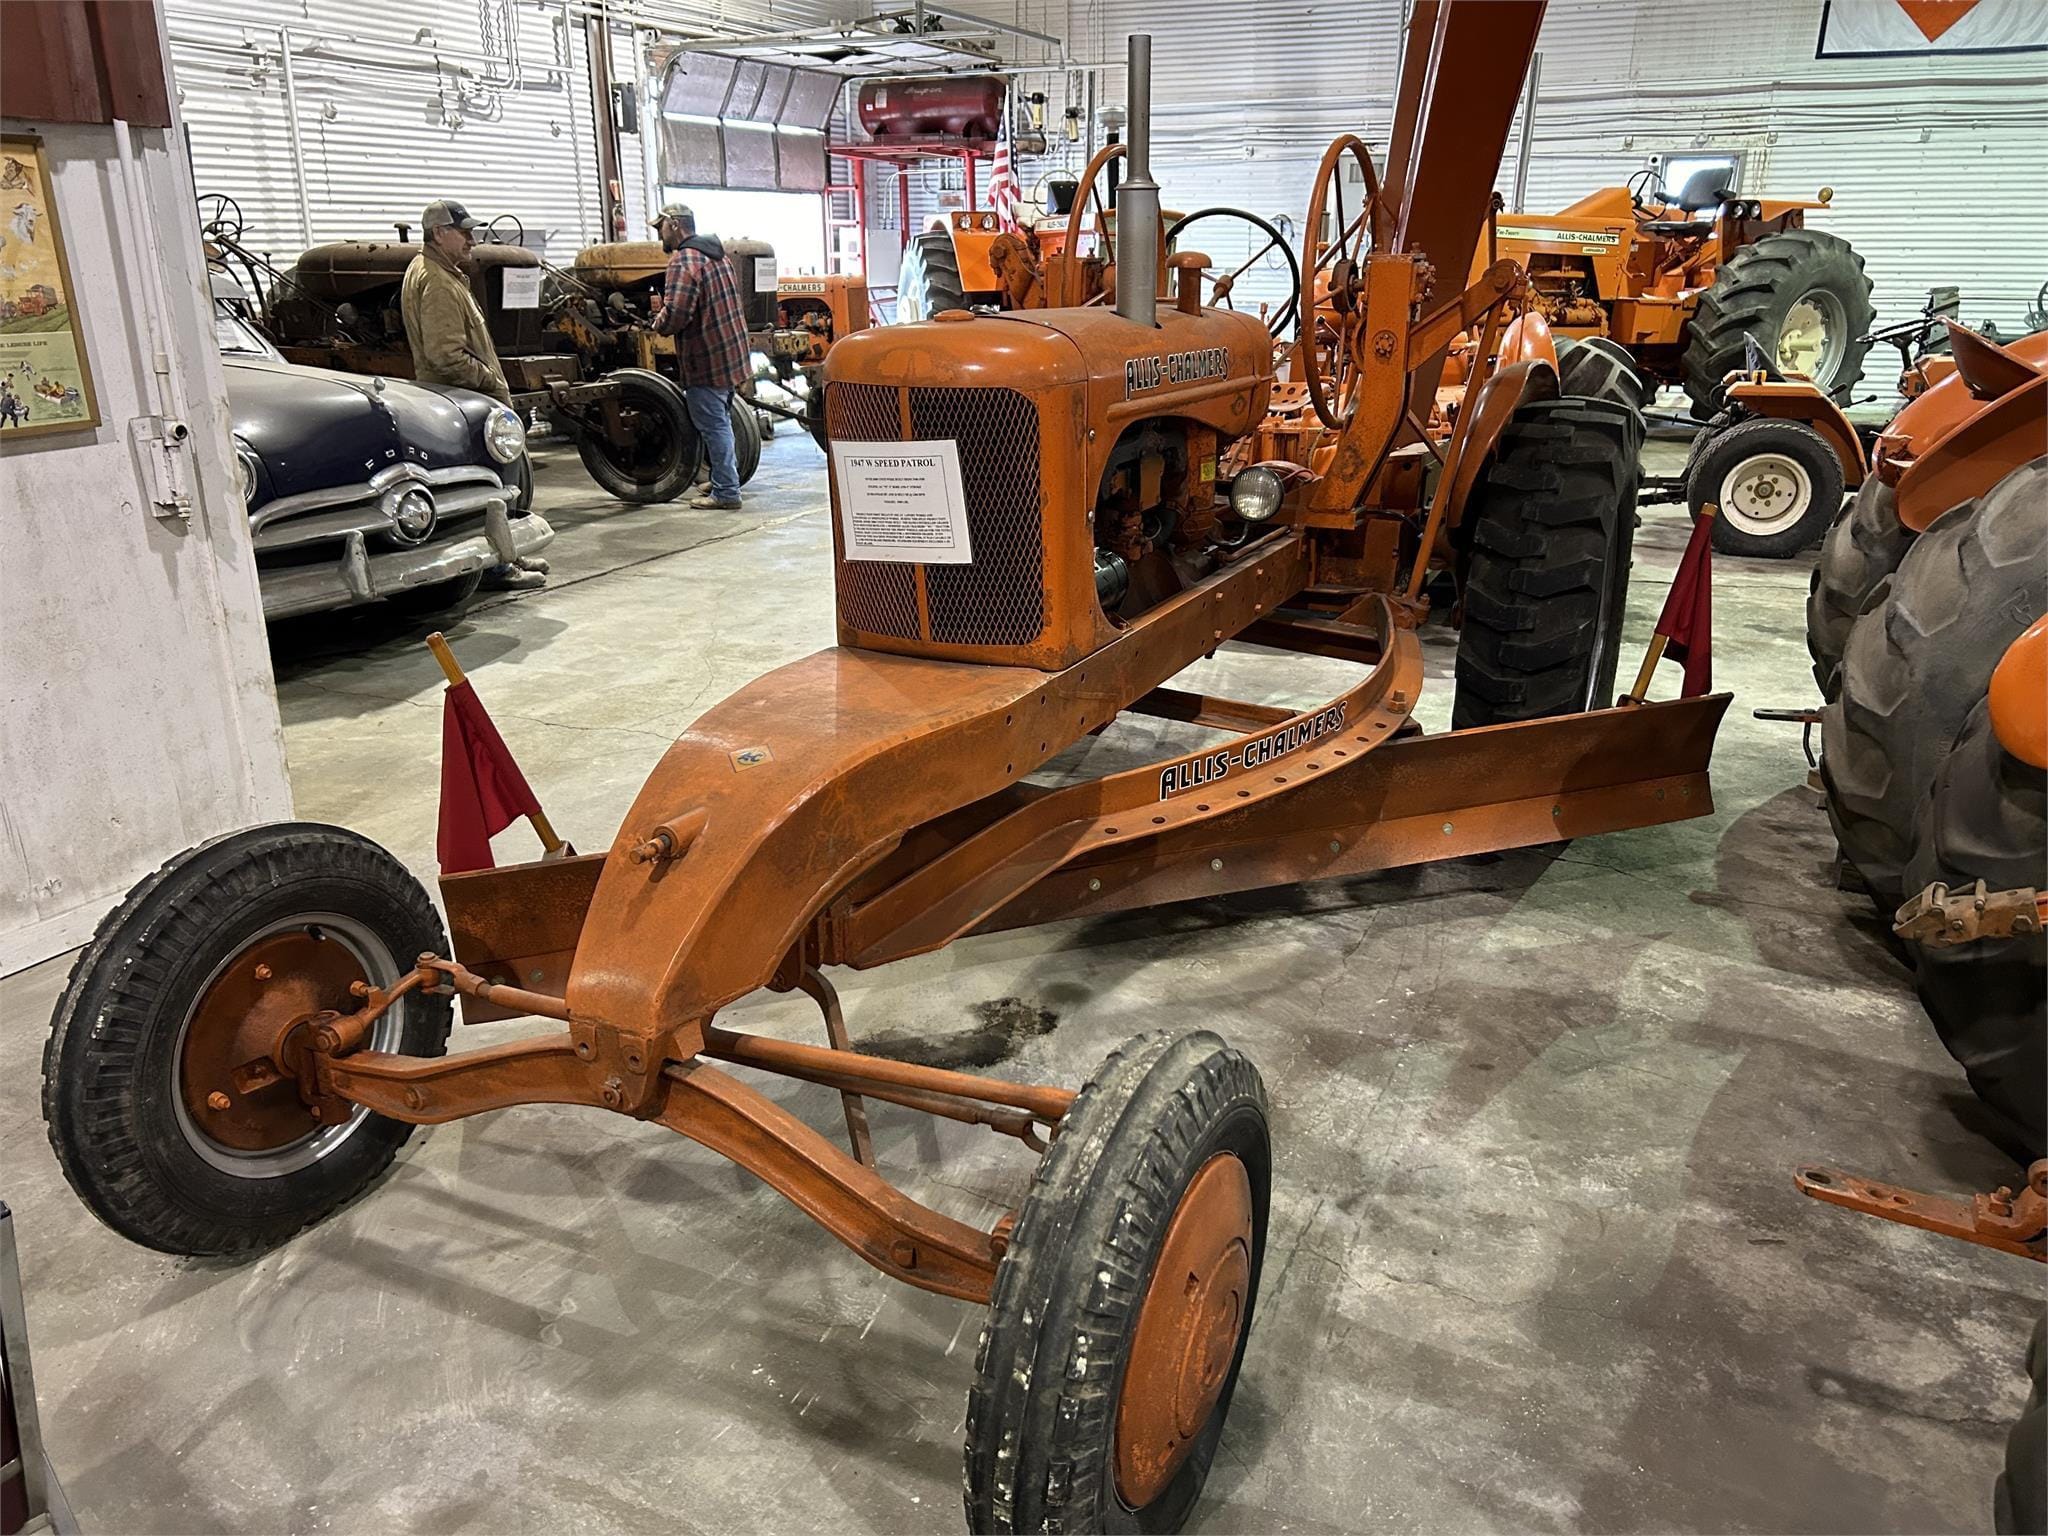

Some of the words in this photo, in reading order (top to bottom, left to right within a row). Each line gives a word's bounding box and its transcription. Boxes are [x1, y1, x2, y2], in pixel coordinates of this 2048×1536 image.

[1556, 231, 1616, 243] ALLIS-CHALMERS
[1125, 346, 1229, 401] ALLIS-CHALMERS
[851, 458, 864, 467] 1947
[865, 458, 873, 467] W
[874, 459, 900, 467] SPEED
[901, 458, 936, 467] PATROL
[1160, 700, 1348, 801] ALLIS-CHALMERS
